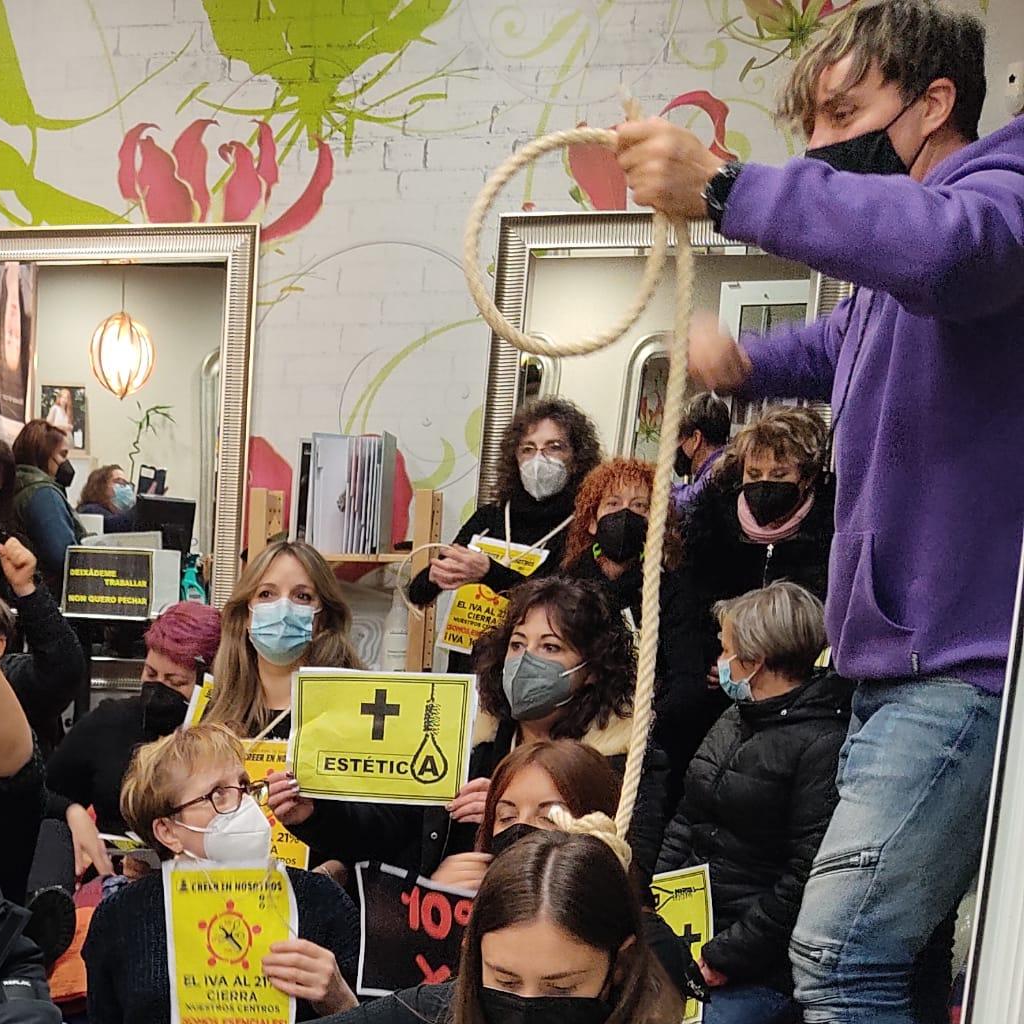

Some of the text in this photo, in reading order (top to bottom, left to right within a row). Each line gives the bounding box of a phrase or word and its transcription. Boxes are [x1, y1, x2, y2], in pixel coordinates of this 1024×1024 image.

[69, 568, 117, 577] DEIXÁDEME
[103, 578, 147, 588] TRABALLAR
[67, 594, 87, 602] NON
[87, 595, 117, 604] QUERO
[457, 600, 467, 609] EL
[469, 603, 483, 613] IVA
[484, 606, 496, 616] AL
[467, 612, 497, 623] CIERRA
[266, 754, 275, 762] EN
[184, 975, 199, 987] EL
[204, 975, 228, 987] IVA
[233, 975, 251, 987] AL
[207, 990, 258, 1002] CIERRA
[185, 1003, 281, 1013] NUESTROS CENTROS
